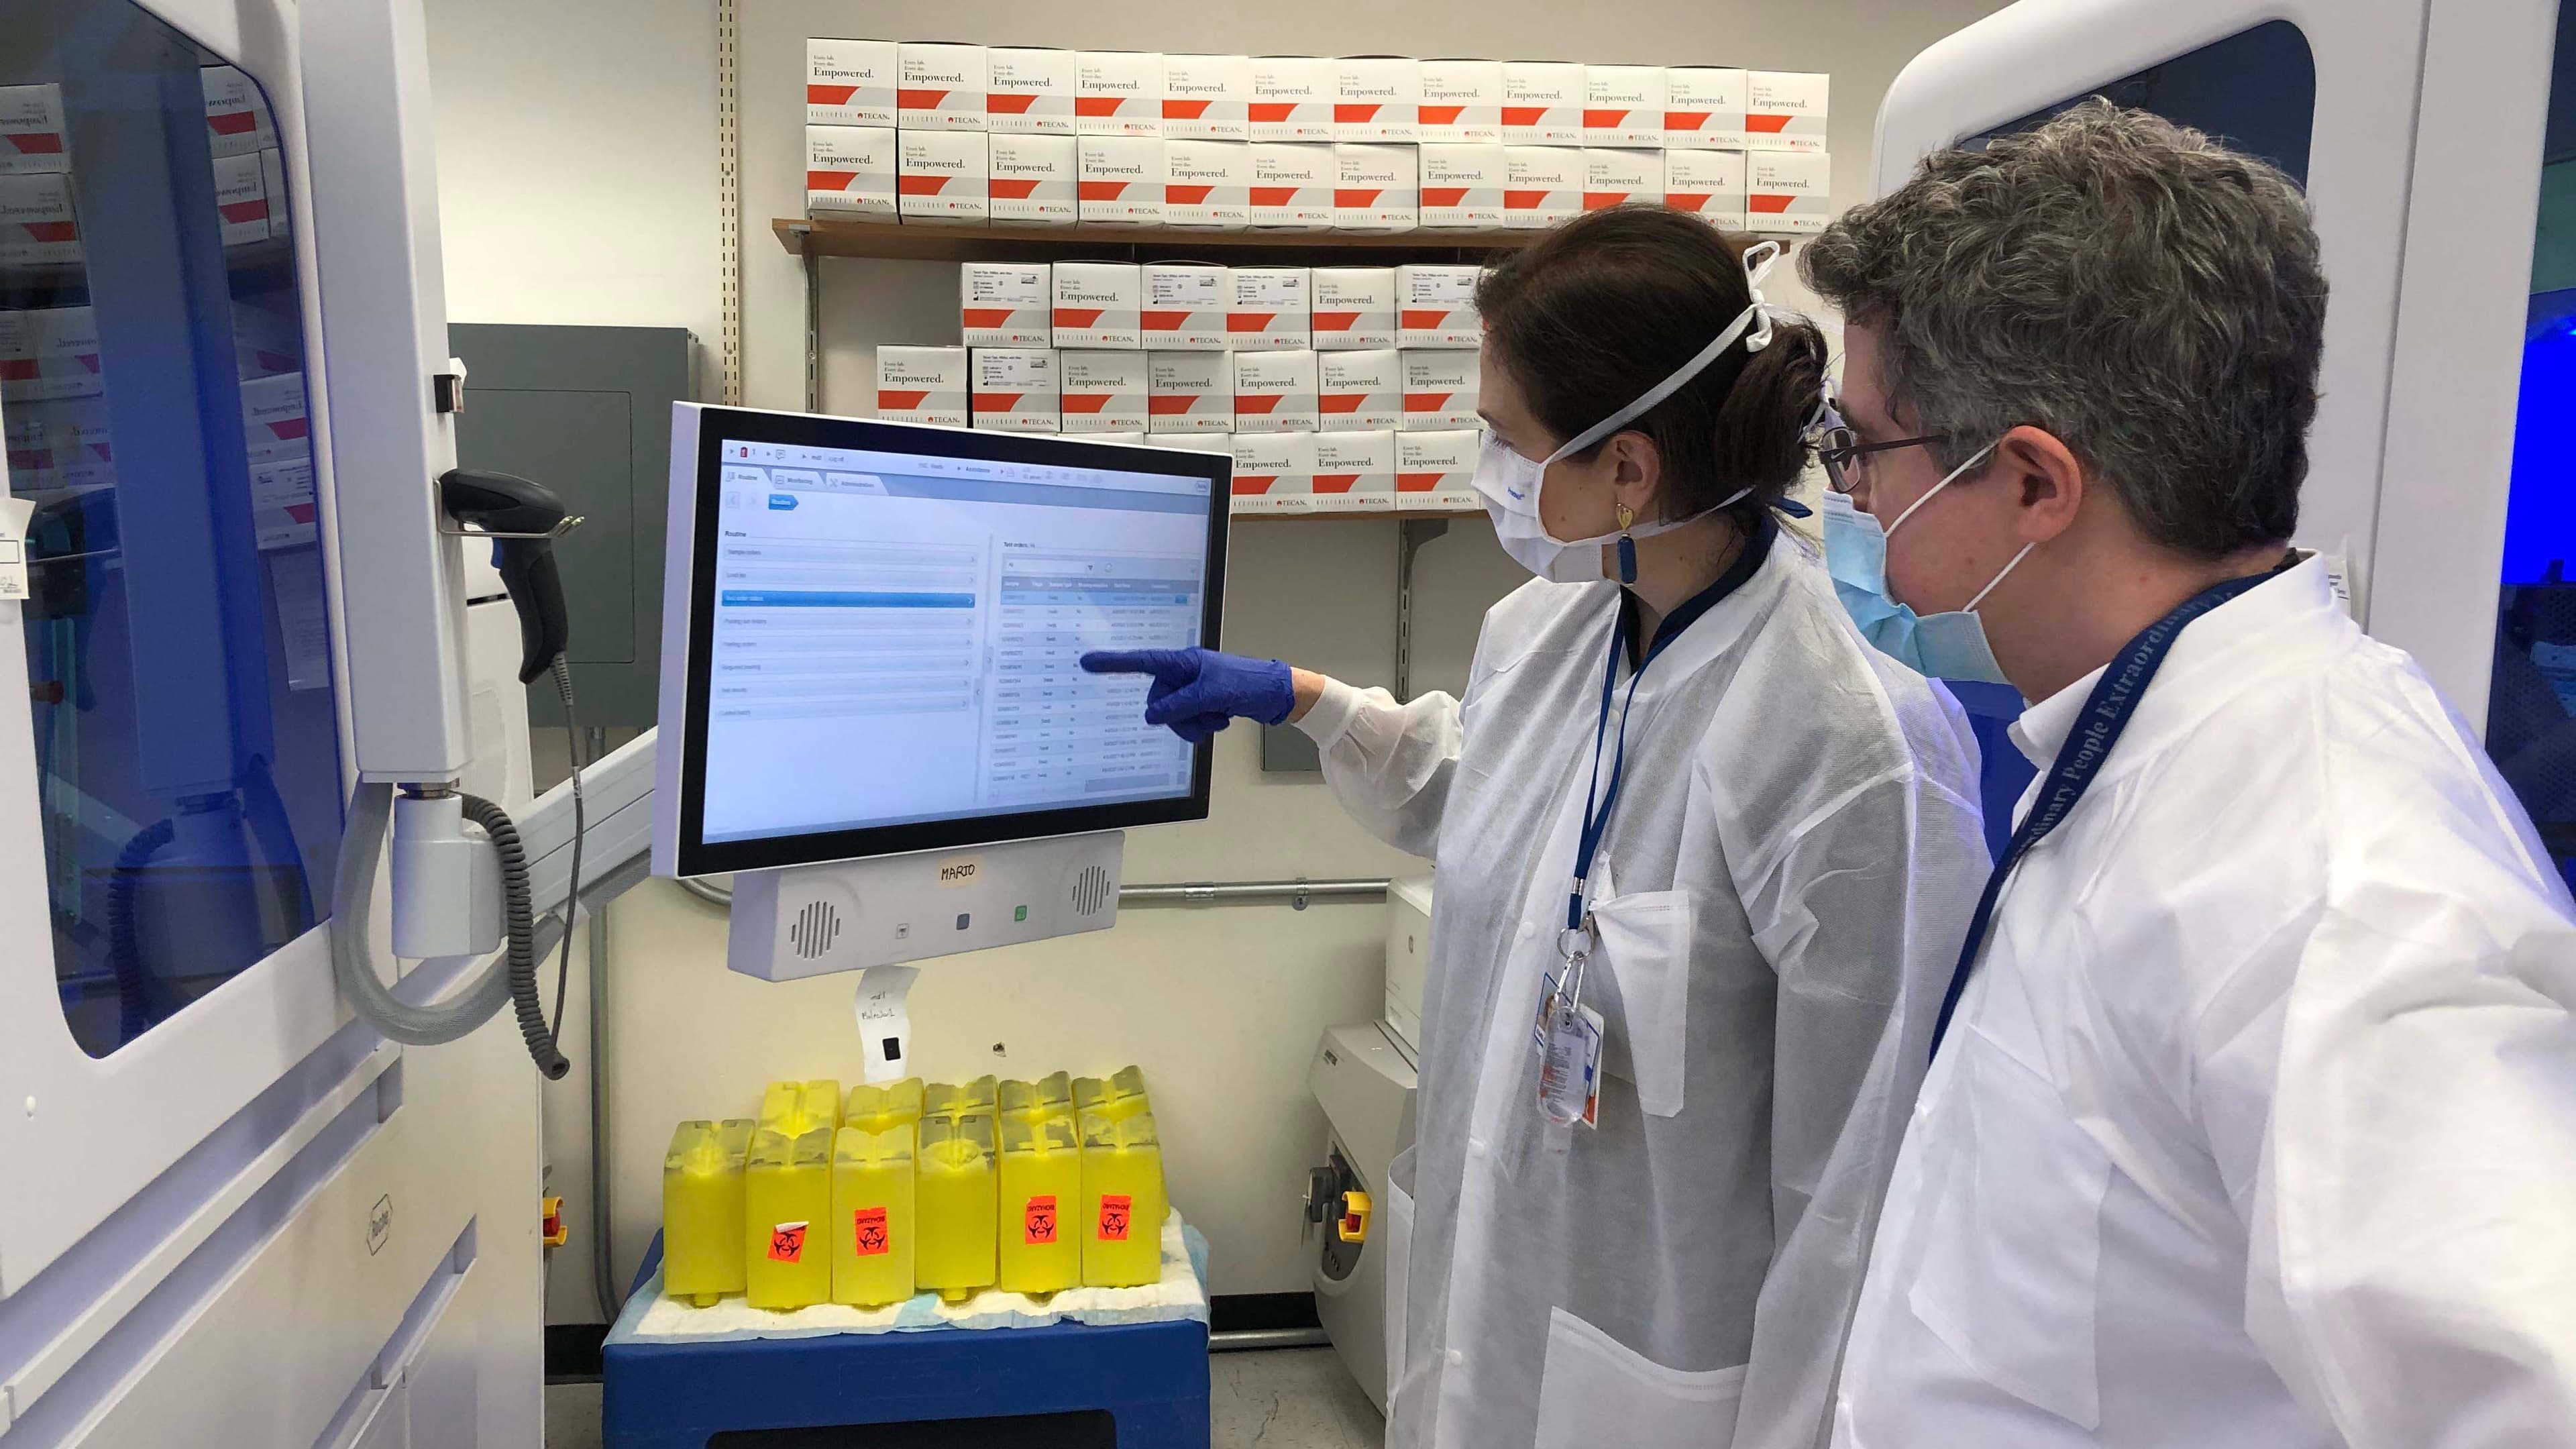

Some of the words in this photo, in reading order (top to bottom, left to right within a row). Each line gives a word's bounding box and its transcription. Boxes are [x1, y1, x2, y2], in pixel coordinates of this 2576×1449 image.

[814, 67, 873, 79] Empowered.
[905, 72, 963, 84] Empowered.
[995, 76, 1052, 88] Empowered.
[1083, 80, 1139, 91] Empowered.
[1170, 83, 1226, 94] Empowered.
[1256, 86, 1311, 97] Empowered.
[1341, 87, 1396, 98] Empowered.
[1424, 89, 1479, 100] Empowered.
[1507, 90, 1562, 101] Empowered.
[1590, 93, 1644, 103] Empowered.
[1672, 95, 1725, 106] Empowered.
[1754, 98, 1807, 109] Empowered.
[814, 154, 873, 165] Empowered.
[907, 158, 965, 170] Empowered.
[997, 162, 1054, 173] Empowered.
[1086, 164, 1143, 176] Empowered.
[1172, 168, 1228, 179] Empowered.
[1257, 170, 1313, 181] Empowered.
[1342, 172, 1396, 183] Empowered.
[1429, 171, 1483, 182] Empowered.
[1509, 174, 1562, 184] Empowered.
[1590, 176, 1643, 186] Empowered.
[1672, 177, 1725, 188] Empowered.
[1757, 178, 1809, 189] Empowered.
[1061, 291, 1118, 303] Empowered.
[1320, 295, 1374, 306] Empowered.
[885, 374, 943, 384] Empowered.
[1069, 376, 1126, 388] Empowered.
[1156, 378, 1212, 390] Empowered.
[1241, 378, 1296, 389] Empowered.
[1326, 376, 1381, 388] Empowered.
[1411, 376, 1464, 388] Empowered.
[1236, 458, 1291, 470] Empowered.
[1319, 457, 1373, 469] Empowered.
[1403, 456, 1458, 468] Empowered.
[2061, 721, 2109, 780] People
[2095, 599, 2212, 719] Extraordinary
[941, 864, 975, 881] MARIO
